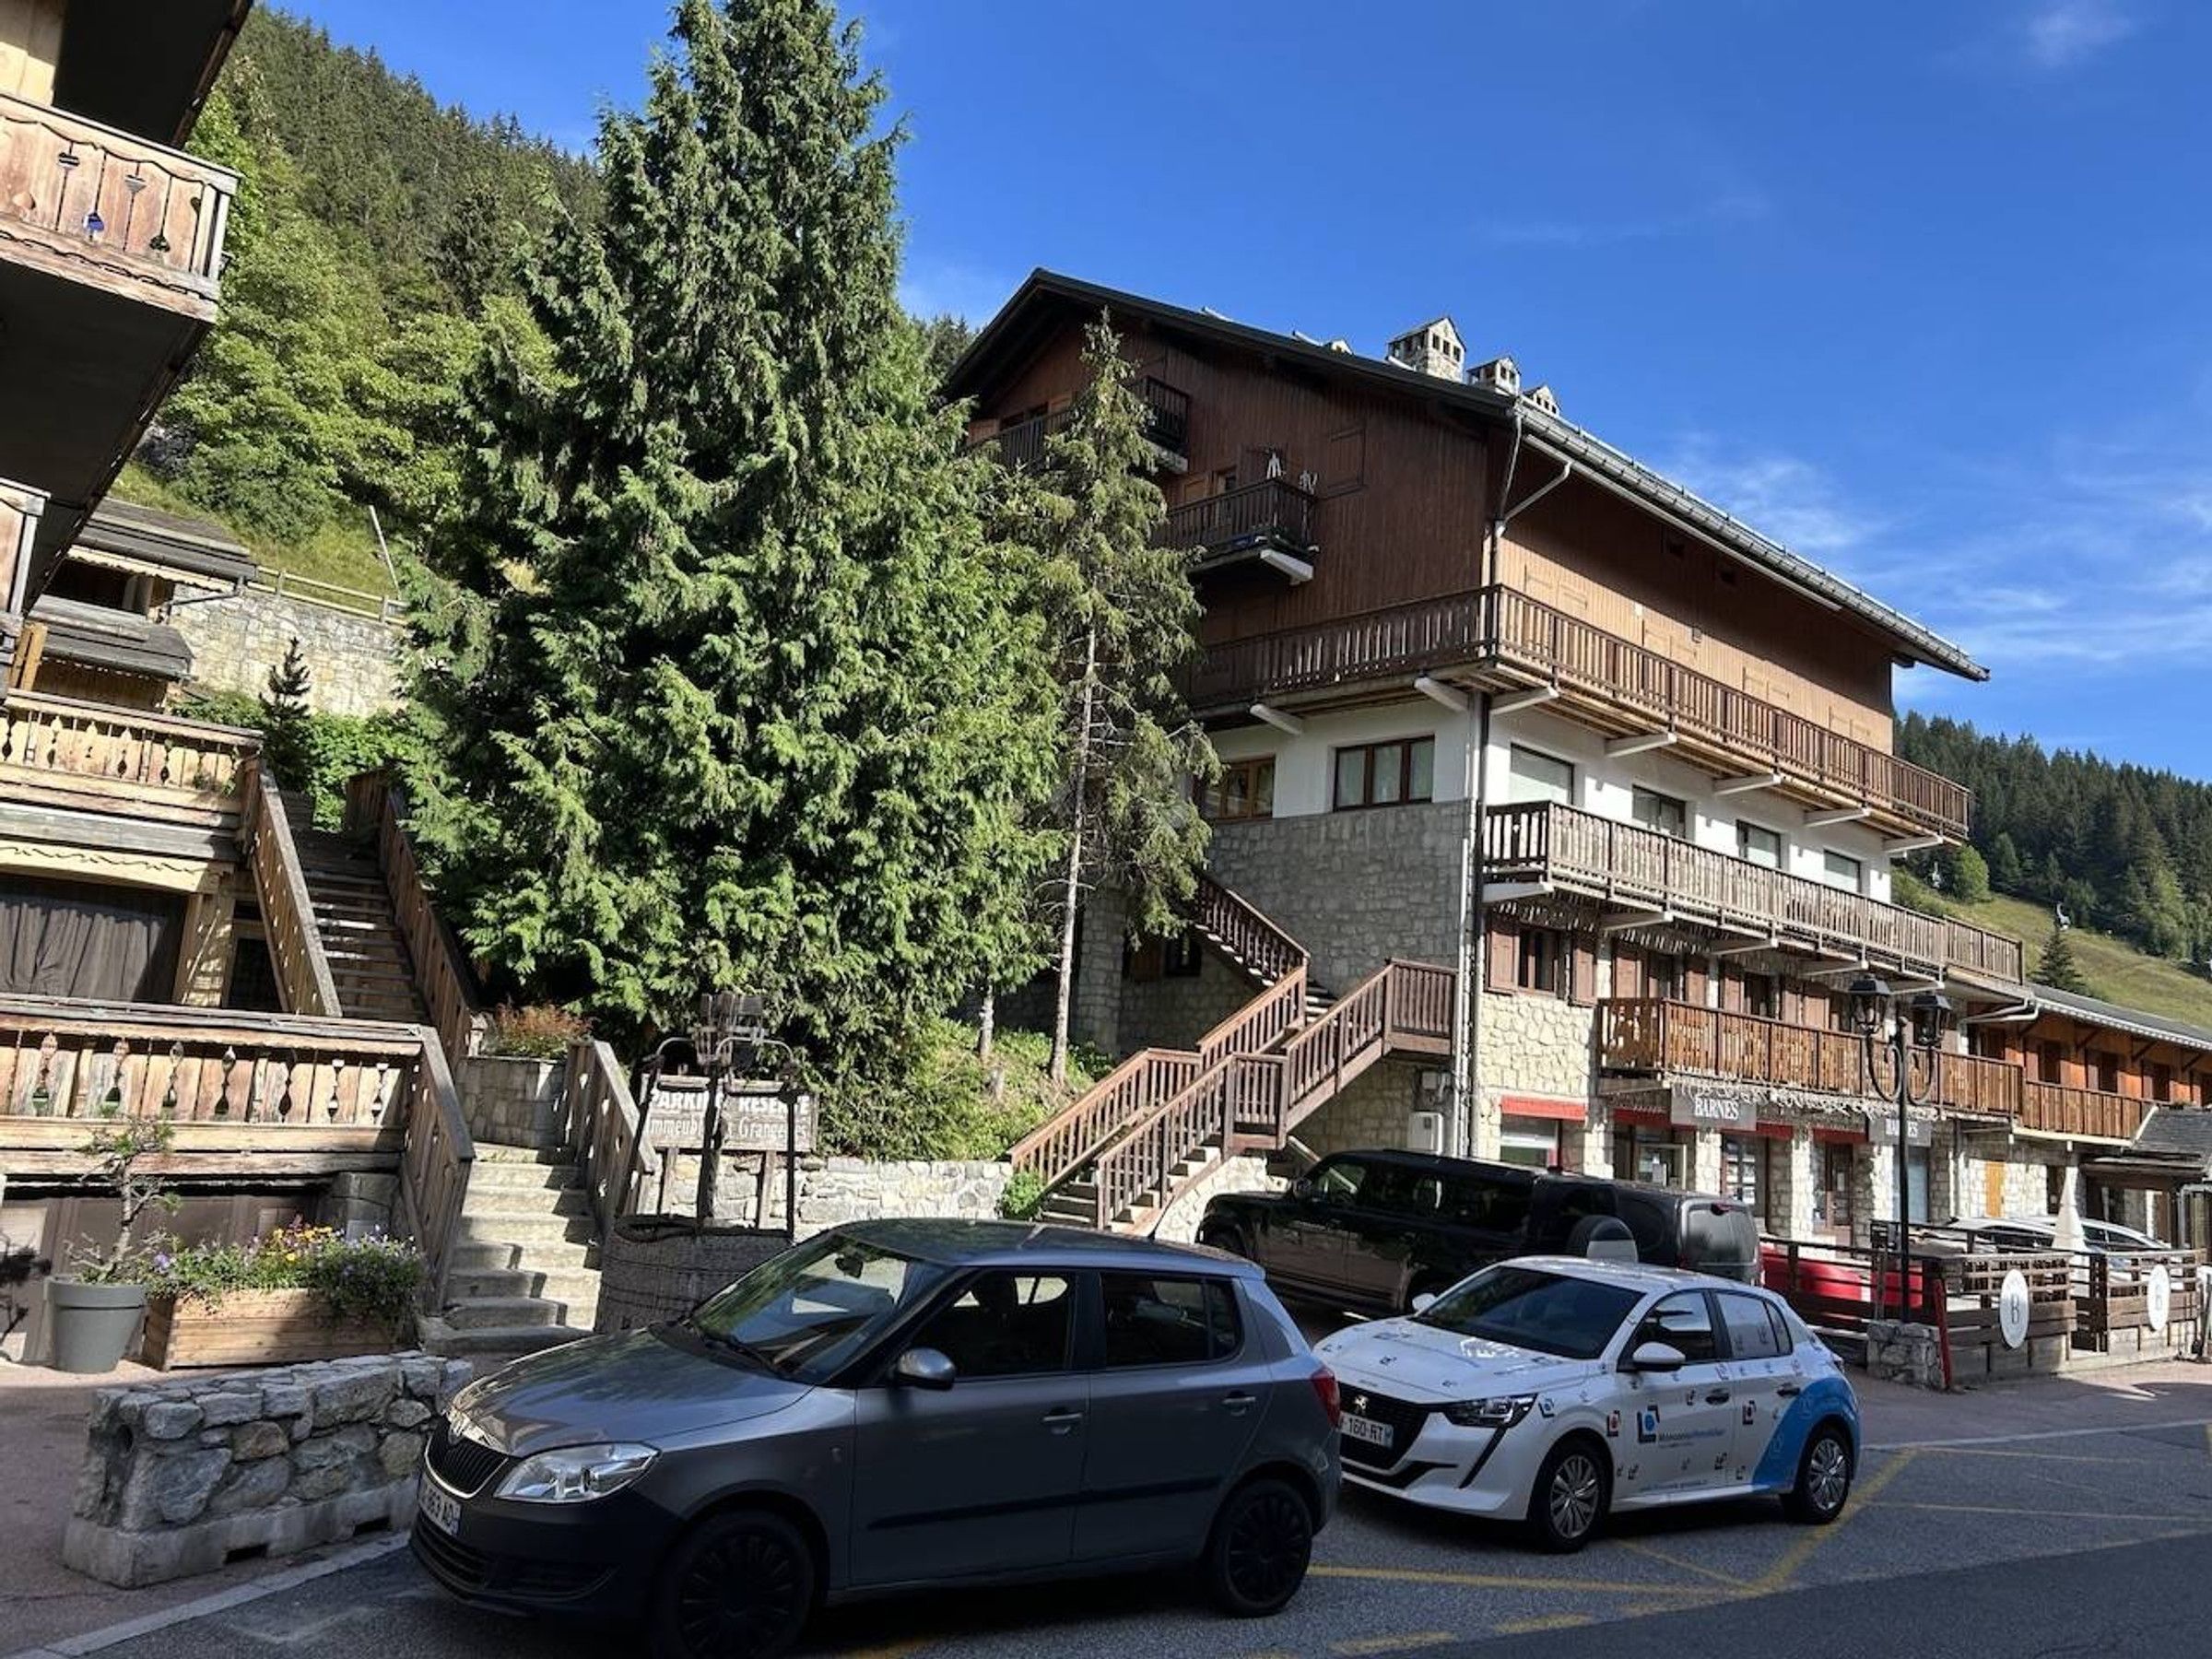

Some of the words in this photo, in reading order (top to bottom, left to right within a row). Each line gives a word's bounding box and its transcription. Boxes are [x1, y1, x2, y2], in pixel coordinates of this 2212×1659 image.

[738, 1095, 811, 1115] RESERE
[1694, 1098, 1739, 1121] BARNES
[1885, 1118, 1918, 1138] BAES
